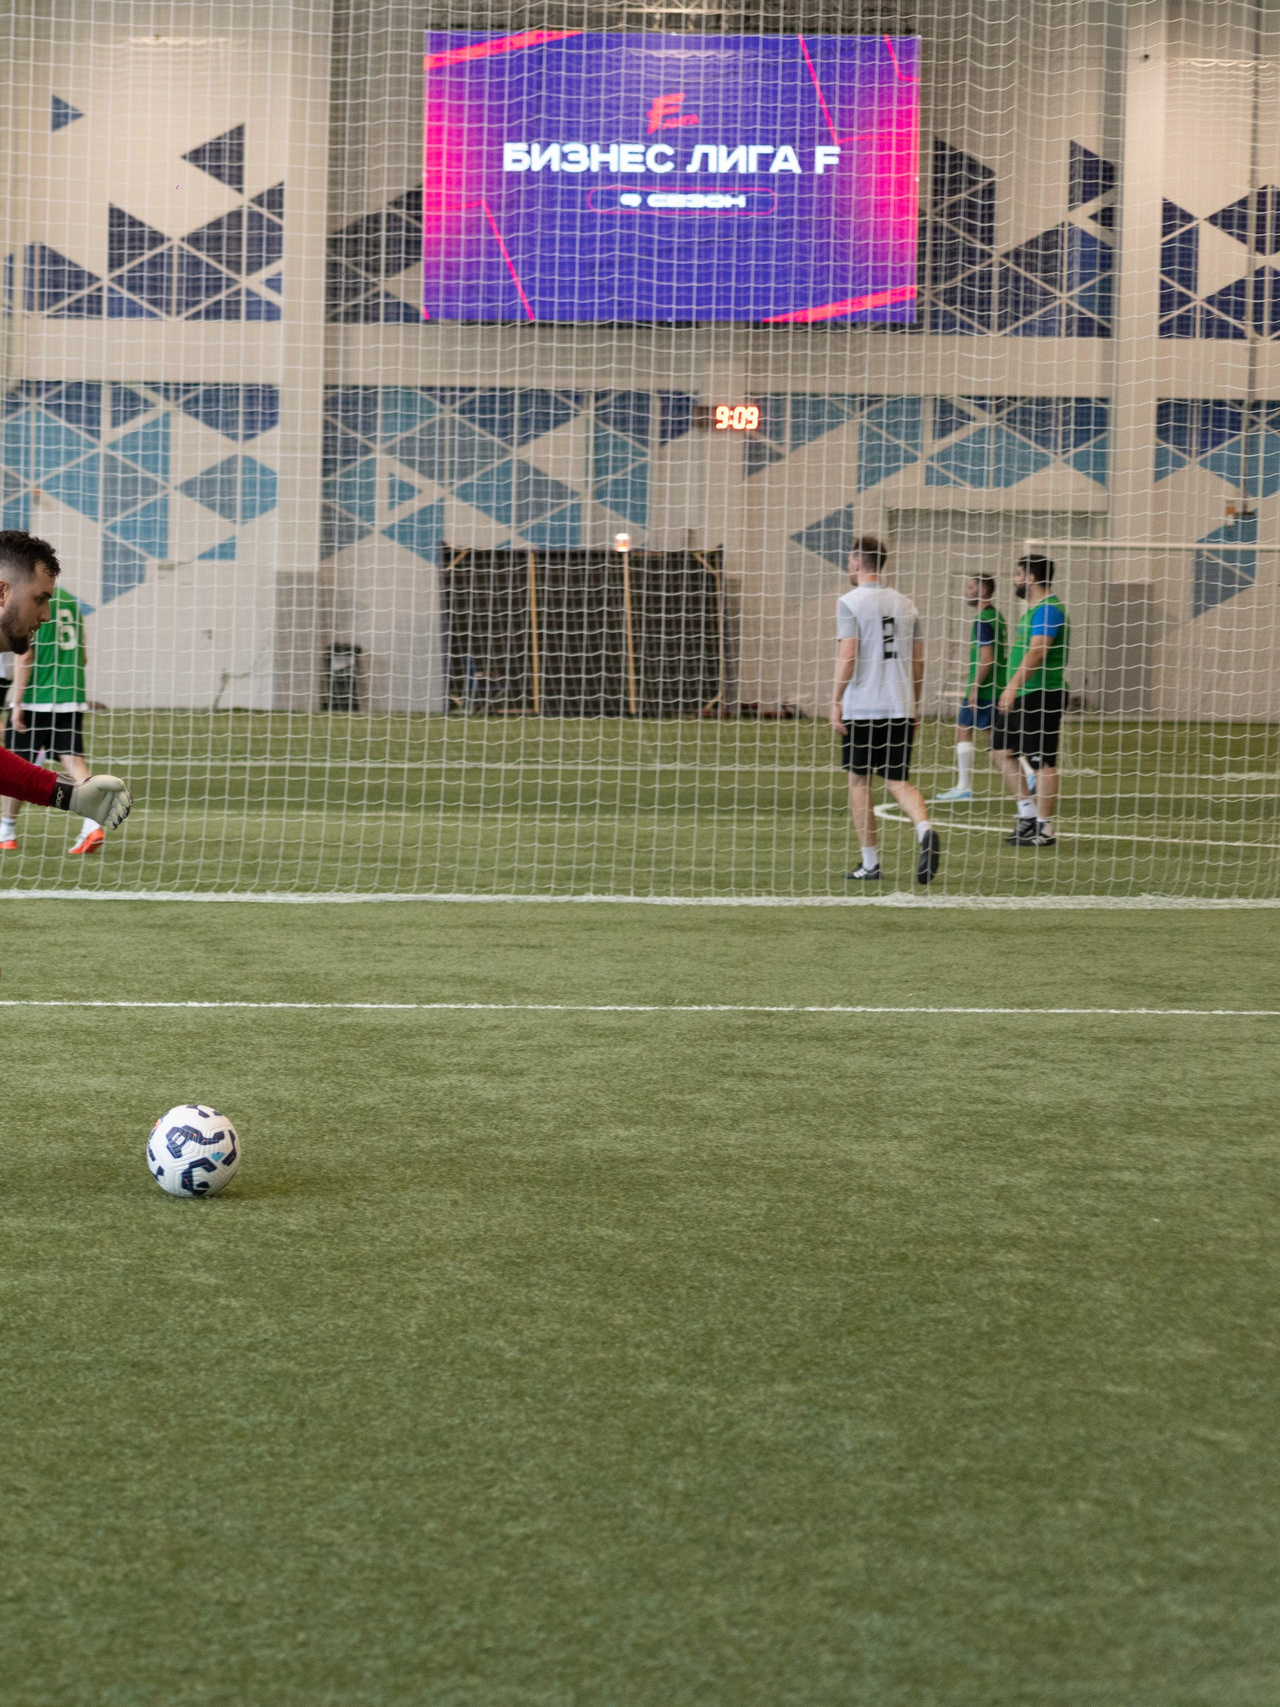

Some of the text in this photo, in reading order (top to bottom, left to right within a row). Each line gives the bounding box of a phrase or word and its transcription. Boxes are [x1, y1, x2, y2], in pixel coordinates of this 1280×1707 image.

[503, 143, 841, 174] БИЗНЕС ЛИГА F
[715, 405, 759, 430] 9:09
[882, 616, 898, 660] 2
